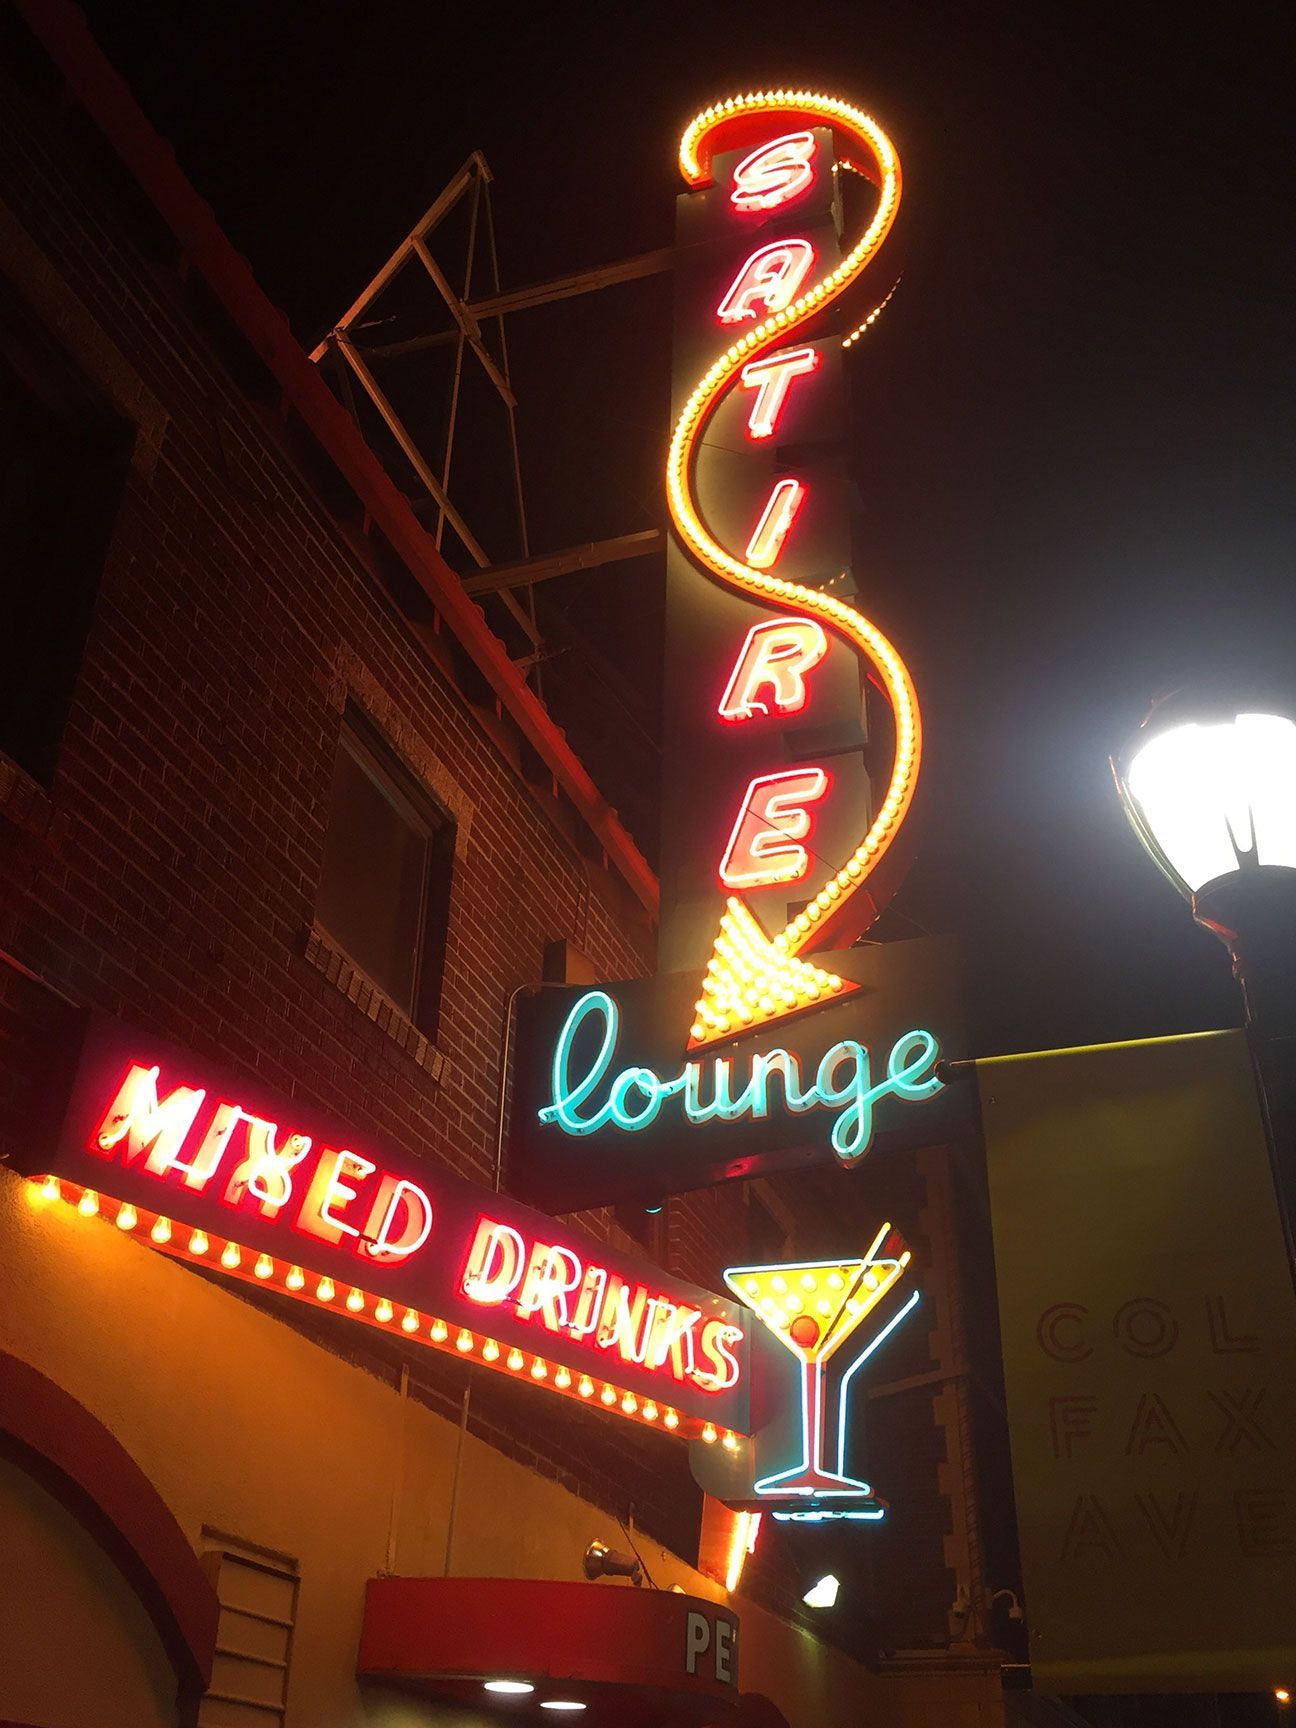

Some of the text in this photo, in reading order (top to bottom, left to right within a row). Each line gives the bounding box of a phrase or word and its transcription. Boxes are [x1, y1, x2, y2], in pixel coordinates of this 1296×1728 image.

[717, 131, 832, 889] SATIRE
[538, 990, 947, 1162] lounge
[90, 1059, 744, 1395] MIXED DRINKS
[1037, 1295, 1264, 1363] COL
[1048, 1387, 1278, 1459] FAX
[1060, 1488, 1296, 1560] AVE
[686, 1611, 737, 1684] PE
